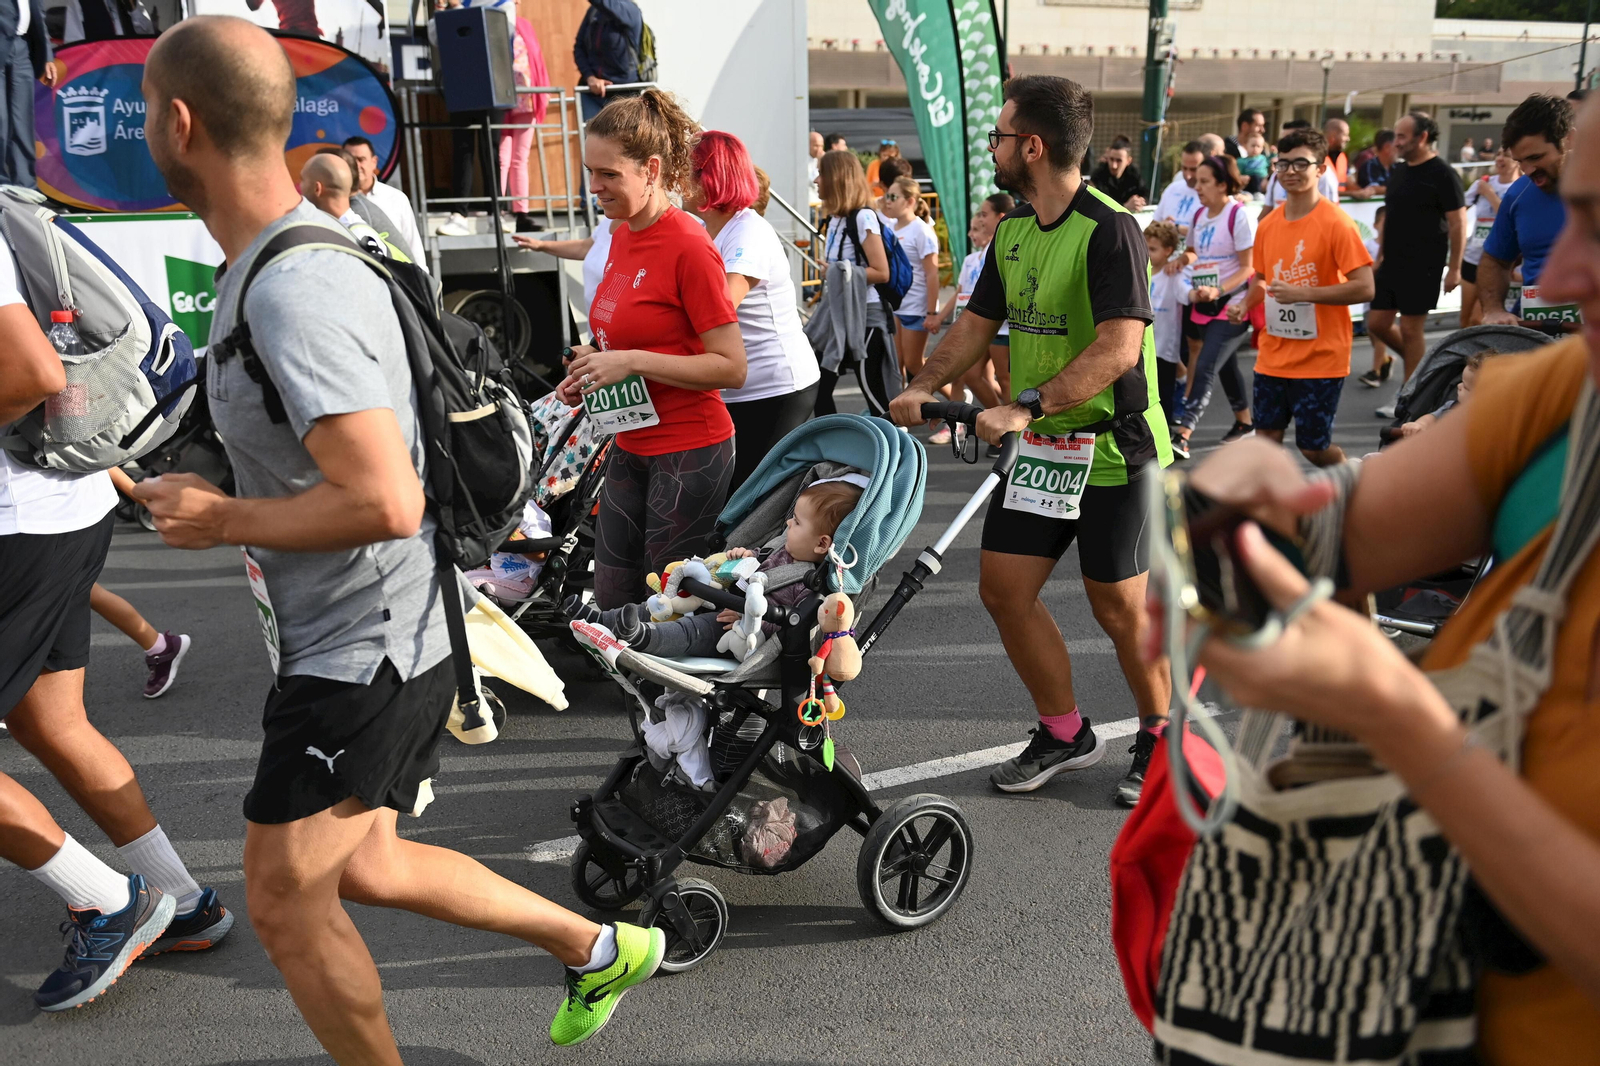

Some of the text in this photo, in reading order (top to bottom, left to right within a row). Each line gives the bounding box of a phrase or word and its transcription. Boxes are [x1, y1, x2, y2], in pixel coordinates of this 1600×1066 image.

[1282, 262, 1317, 282] BEER
[1279, 308, 1296, 323] 20
[587, 381, 643, 413] 20110
[1013, 462, 1083, 494] 20004
